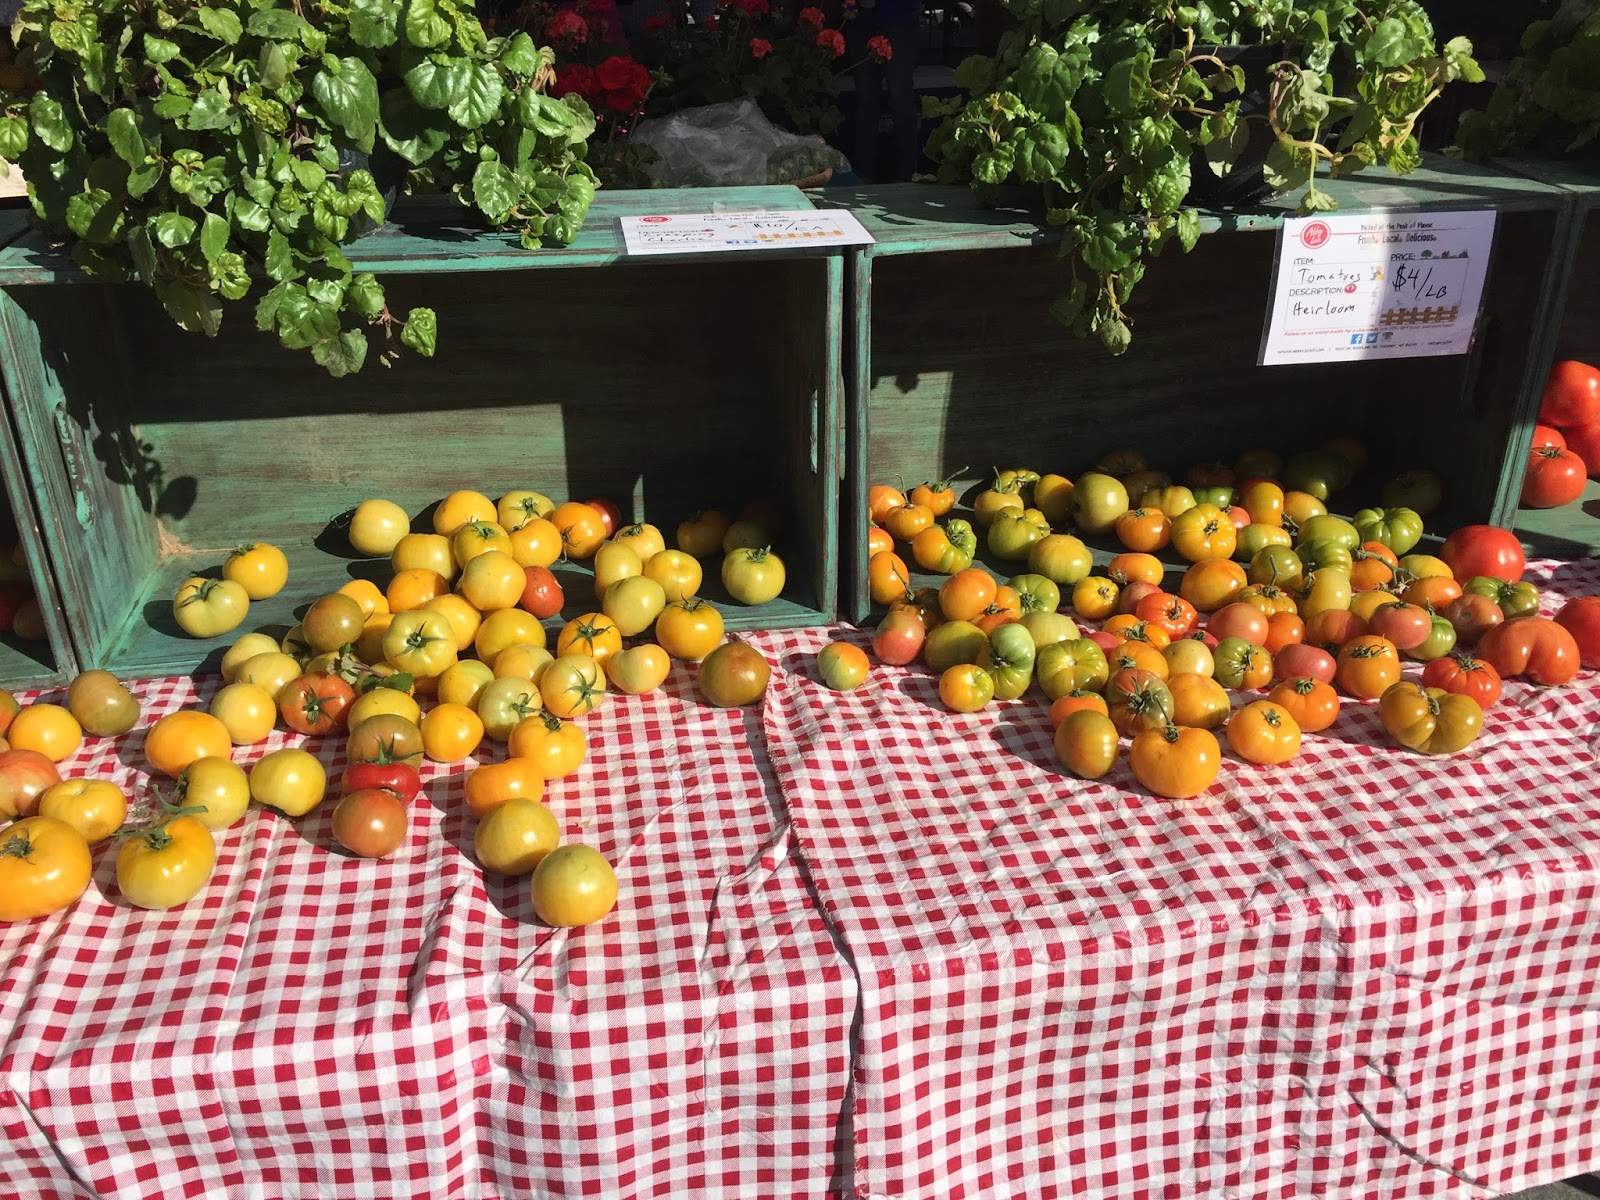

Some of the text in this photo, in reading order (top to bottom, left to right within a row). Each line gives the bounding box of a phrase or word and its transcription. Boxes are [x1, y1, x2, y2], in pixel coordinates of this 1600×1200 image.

[1387, 222, 1395, 230] the
[1397, 222, 1408, 230] Peak
[1391, 252, 1416, 261] PRICE:
[1289, 287, 1344, 297] DESCRIPTION:
[1293, 300, 1355, 316] Heirloom
